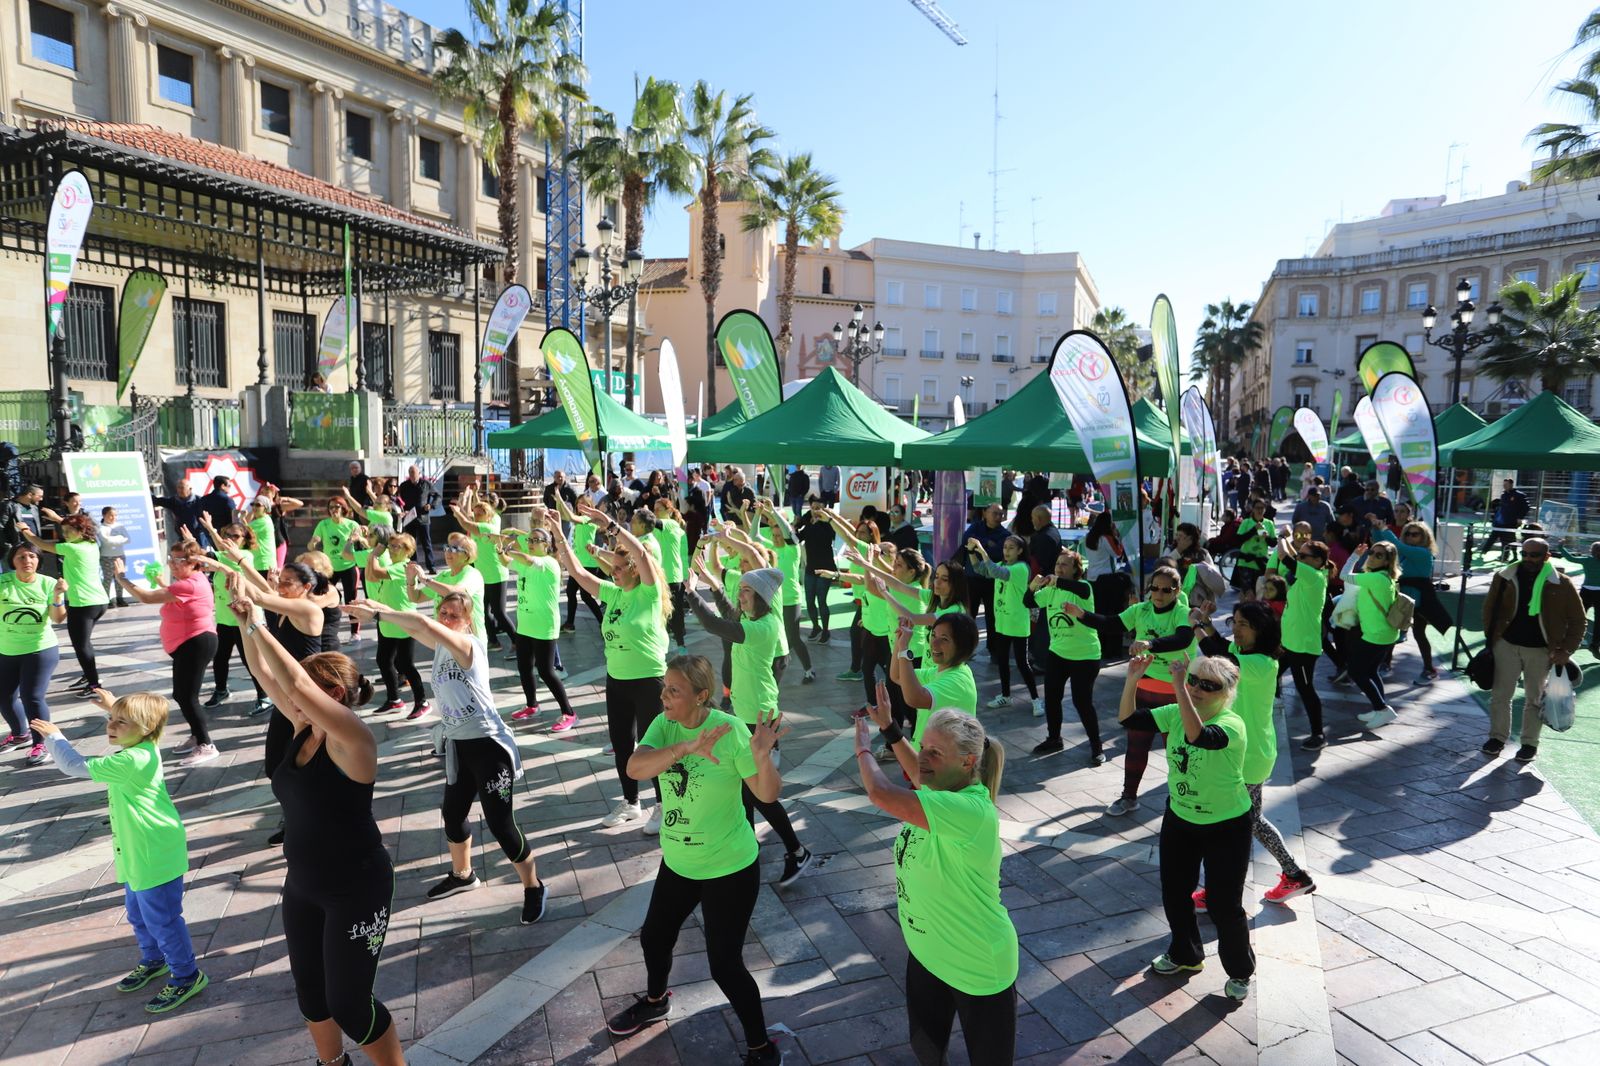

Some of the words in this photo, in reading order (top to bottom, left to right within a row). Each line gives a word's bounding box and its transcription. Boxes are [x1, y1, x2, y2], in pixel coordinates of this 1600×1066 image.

[346, 15, 373, 40] DE
[86, 479, 138, 489] IBERDROLA
[852, 480, 879, 493] RFETM
